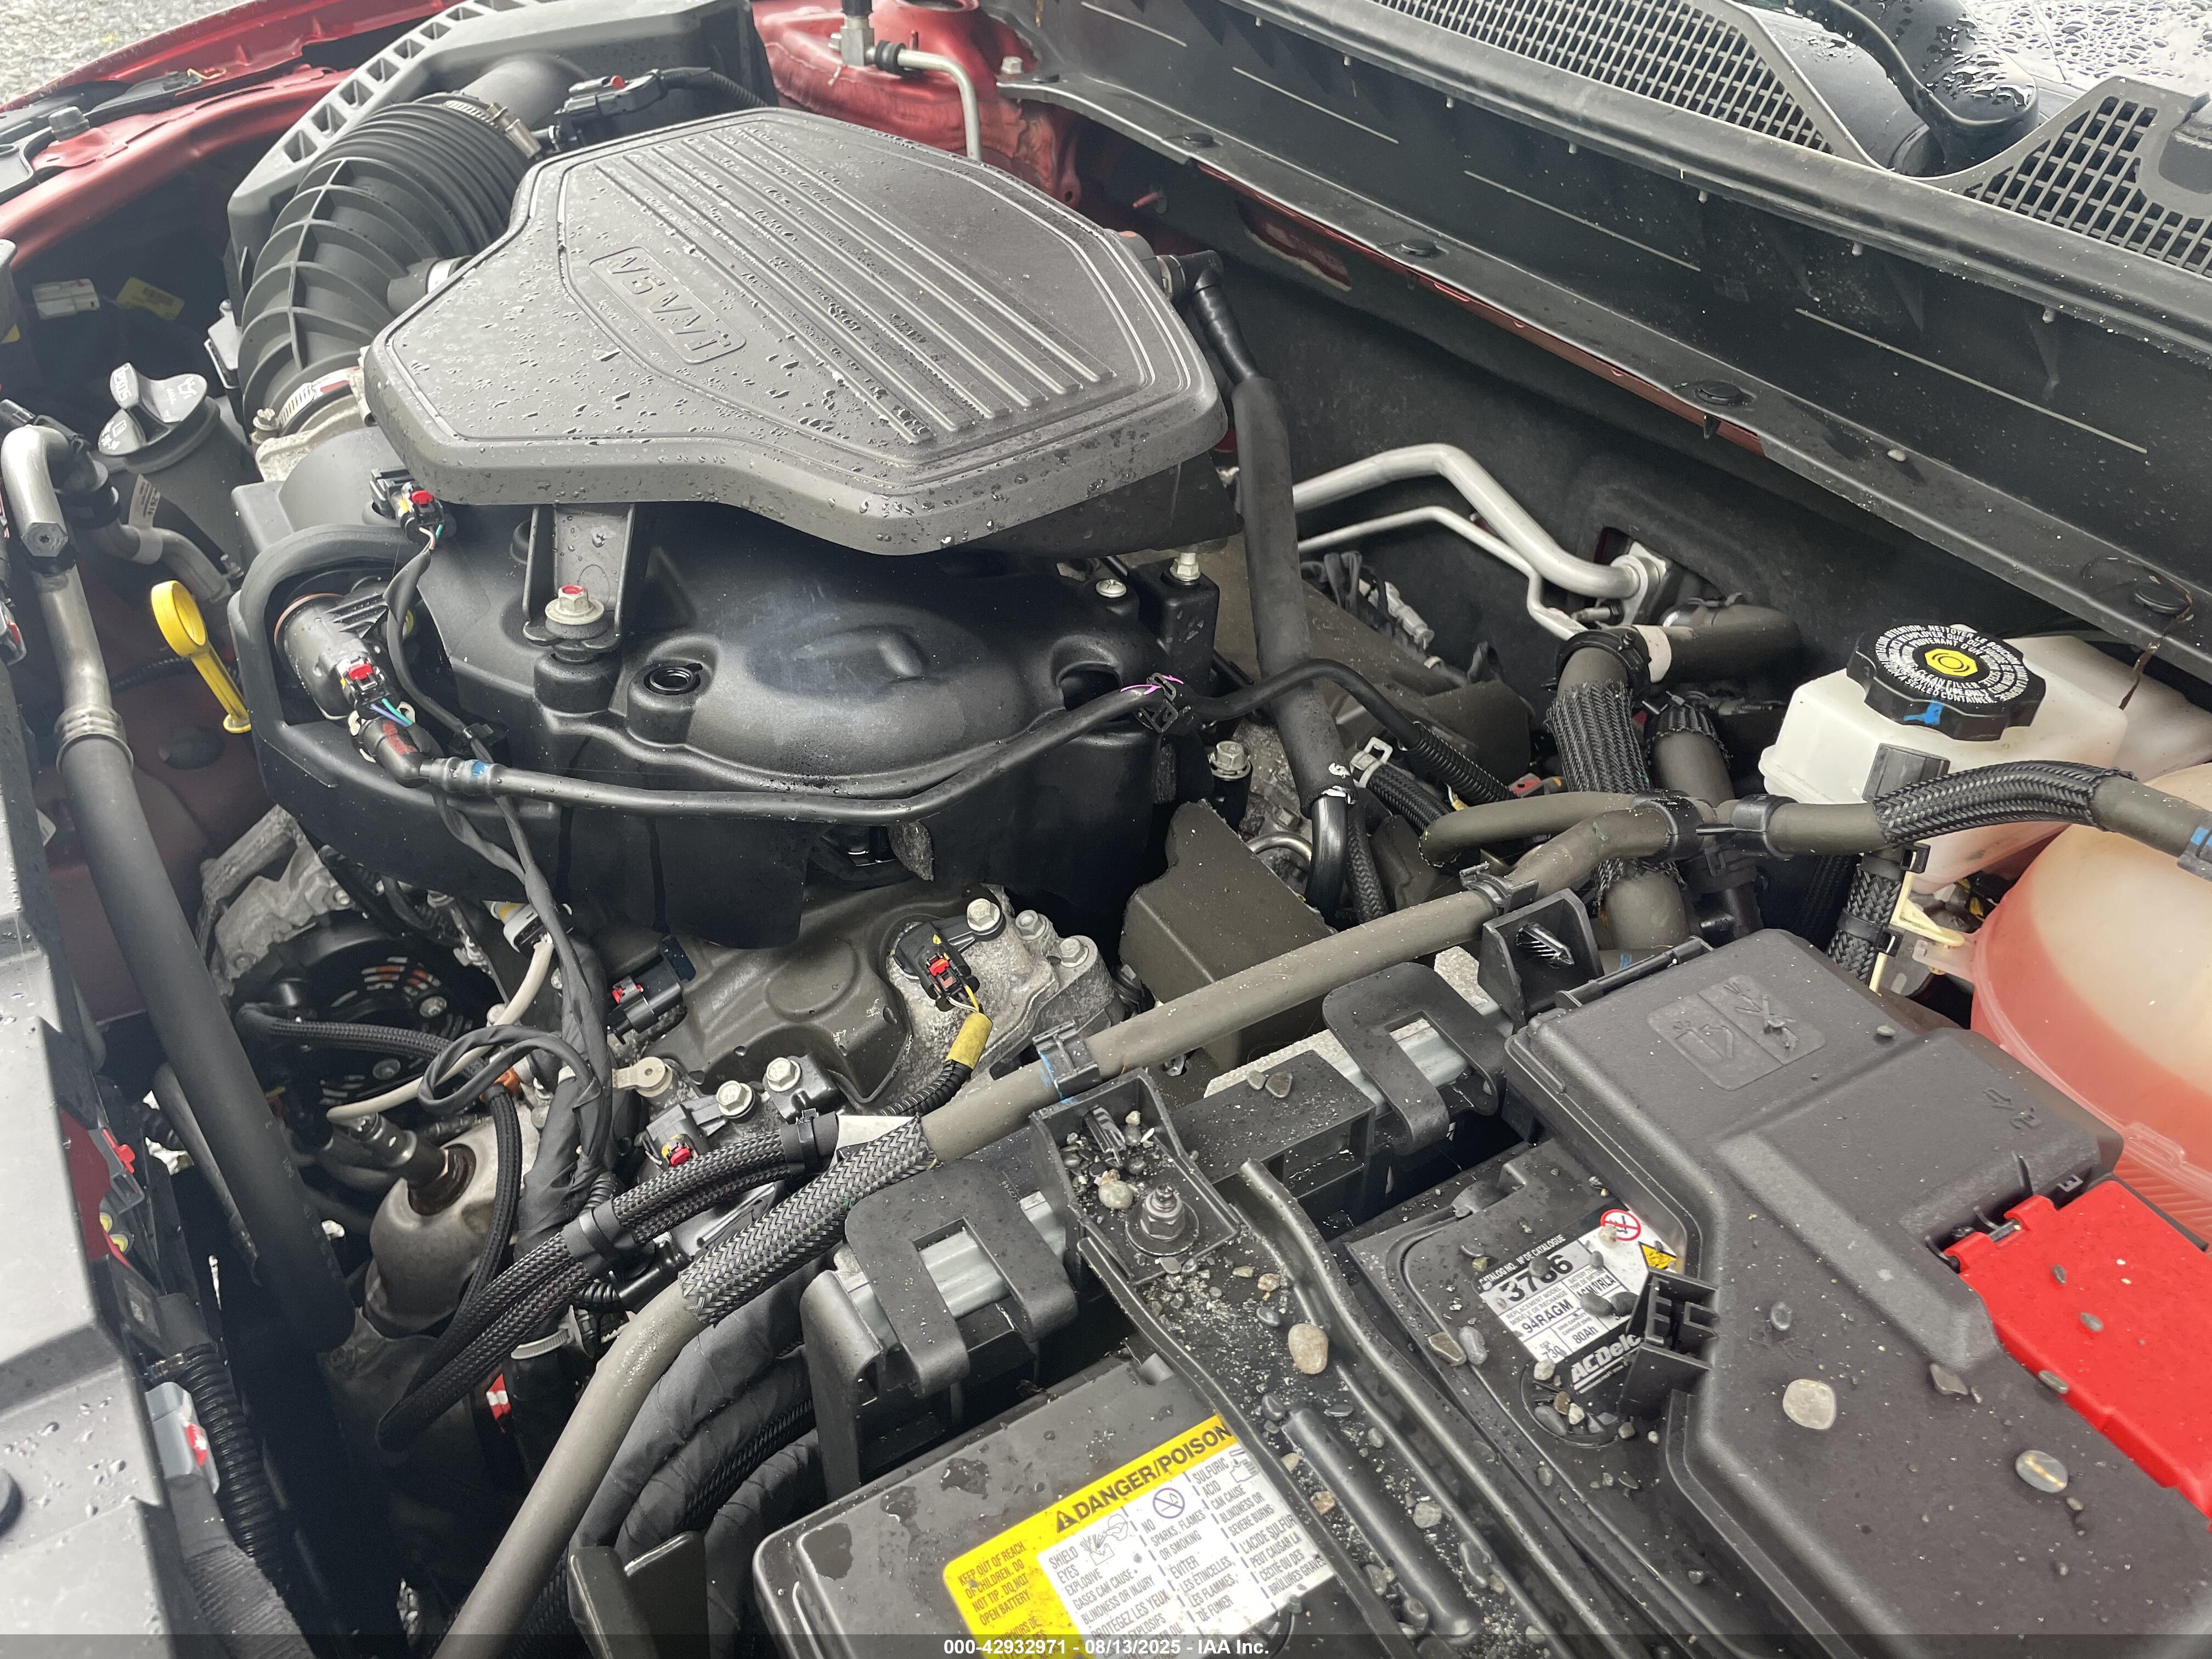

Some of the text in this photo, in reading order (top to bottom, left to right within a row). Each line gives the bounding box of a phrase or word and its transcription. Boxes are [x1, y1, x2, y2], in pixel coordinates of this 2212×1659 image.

[606, 254, 731, 352] V6 VVT
[1530, 1234, 1567, 1257] CATALOGUE
[1584, 1265, 1595, 1274] TYP
[1505, 1285, 1562, 1320] REPLACEMENT MODEL
[1522, 1298, 1574, 1334] 94RAGM
[1571, 1323, 1599, 1345] 80Ah
[1571, 1333, 1642, 1384] ACDelc
[1191, 1457, 1231, 1485] SULFURIC
[1200, 1479, 1222, 1498] ACID
[1209, 1483, 1247, 1510] CAN CAUSE
[1218, 1491, 1265, 1523] BLINDNESS OR
[1227, 1503, 1276, 1537] SEVERE BURNS
[1140, 1517, 1156, 1534] NO
[1149, 1508, 1206, 1548] SPARKS, FLAMES
[1238, 1513, 1297, 1555] L'ACIDE SULFUR
[1048, 1544, 1079, 1571] SHIELD
[1158, 1528, 1203, 1560] OR SMOKING
[1249, 1531, 1302, 1568] PEUT CAUSAR LA
[1278, 1555, 1293, 1570] OU
[1287, 1548, 1306, 1565] DES
[957, 1567, 977, 1587] KEEP
[975, 1559, 992, 1576] OUT
[990, 1553, 1003, 1568] OF
[964, 1584, 978, 1600] OF
[1011, 1558, 1025, 1572] DO
[1056, 1562, 1080, 1585] EYES
[1064, 1567, 1103, 1598] EXPLOSIVE
[1178, 1577, 1196, 1594] LES
[971, 1595, 989, 1613] NOT
[1001, 1581, 1015, 1596] DO
[1012, 1572, 1030, 1589] NOT
[1071, 1567, 1135, 1612] GASES CAN CAUSE
[1080, 1574, 1156, 1626] BLINDNESS OR INJURY
[1130, 1600, 1150, 1621] LES
[1144, 1588, 1171, 1611] YEUX
[1187, 1592, 1205, 1608] LES
[1206, 1593, 1234, 1616] FUMER
[979, 1588, 1031, 1627] OPEN BATTERY
